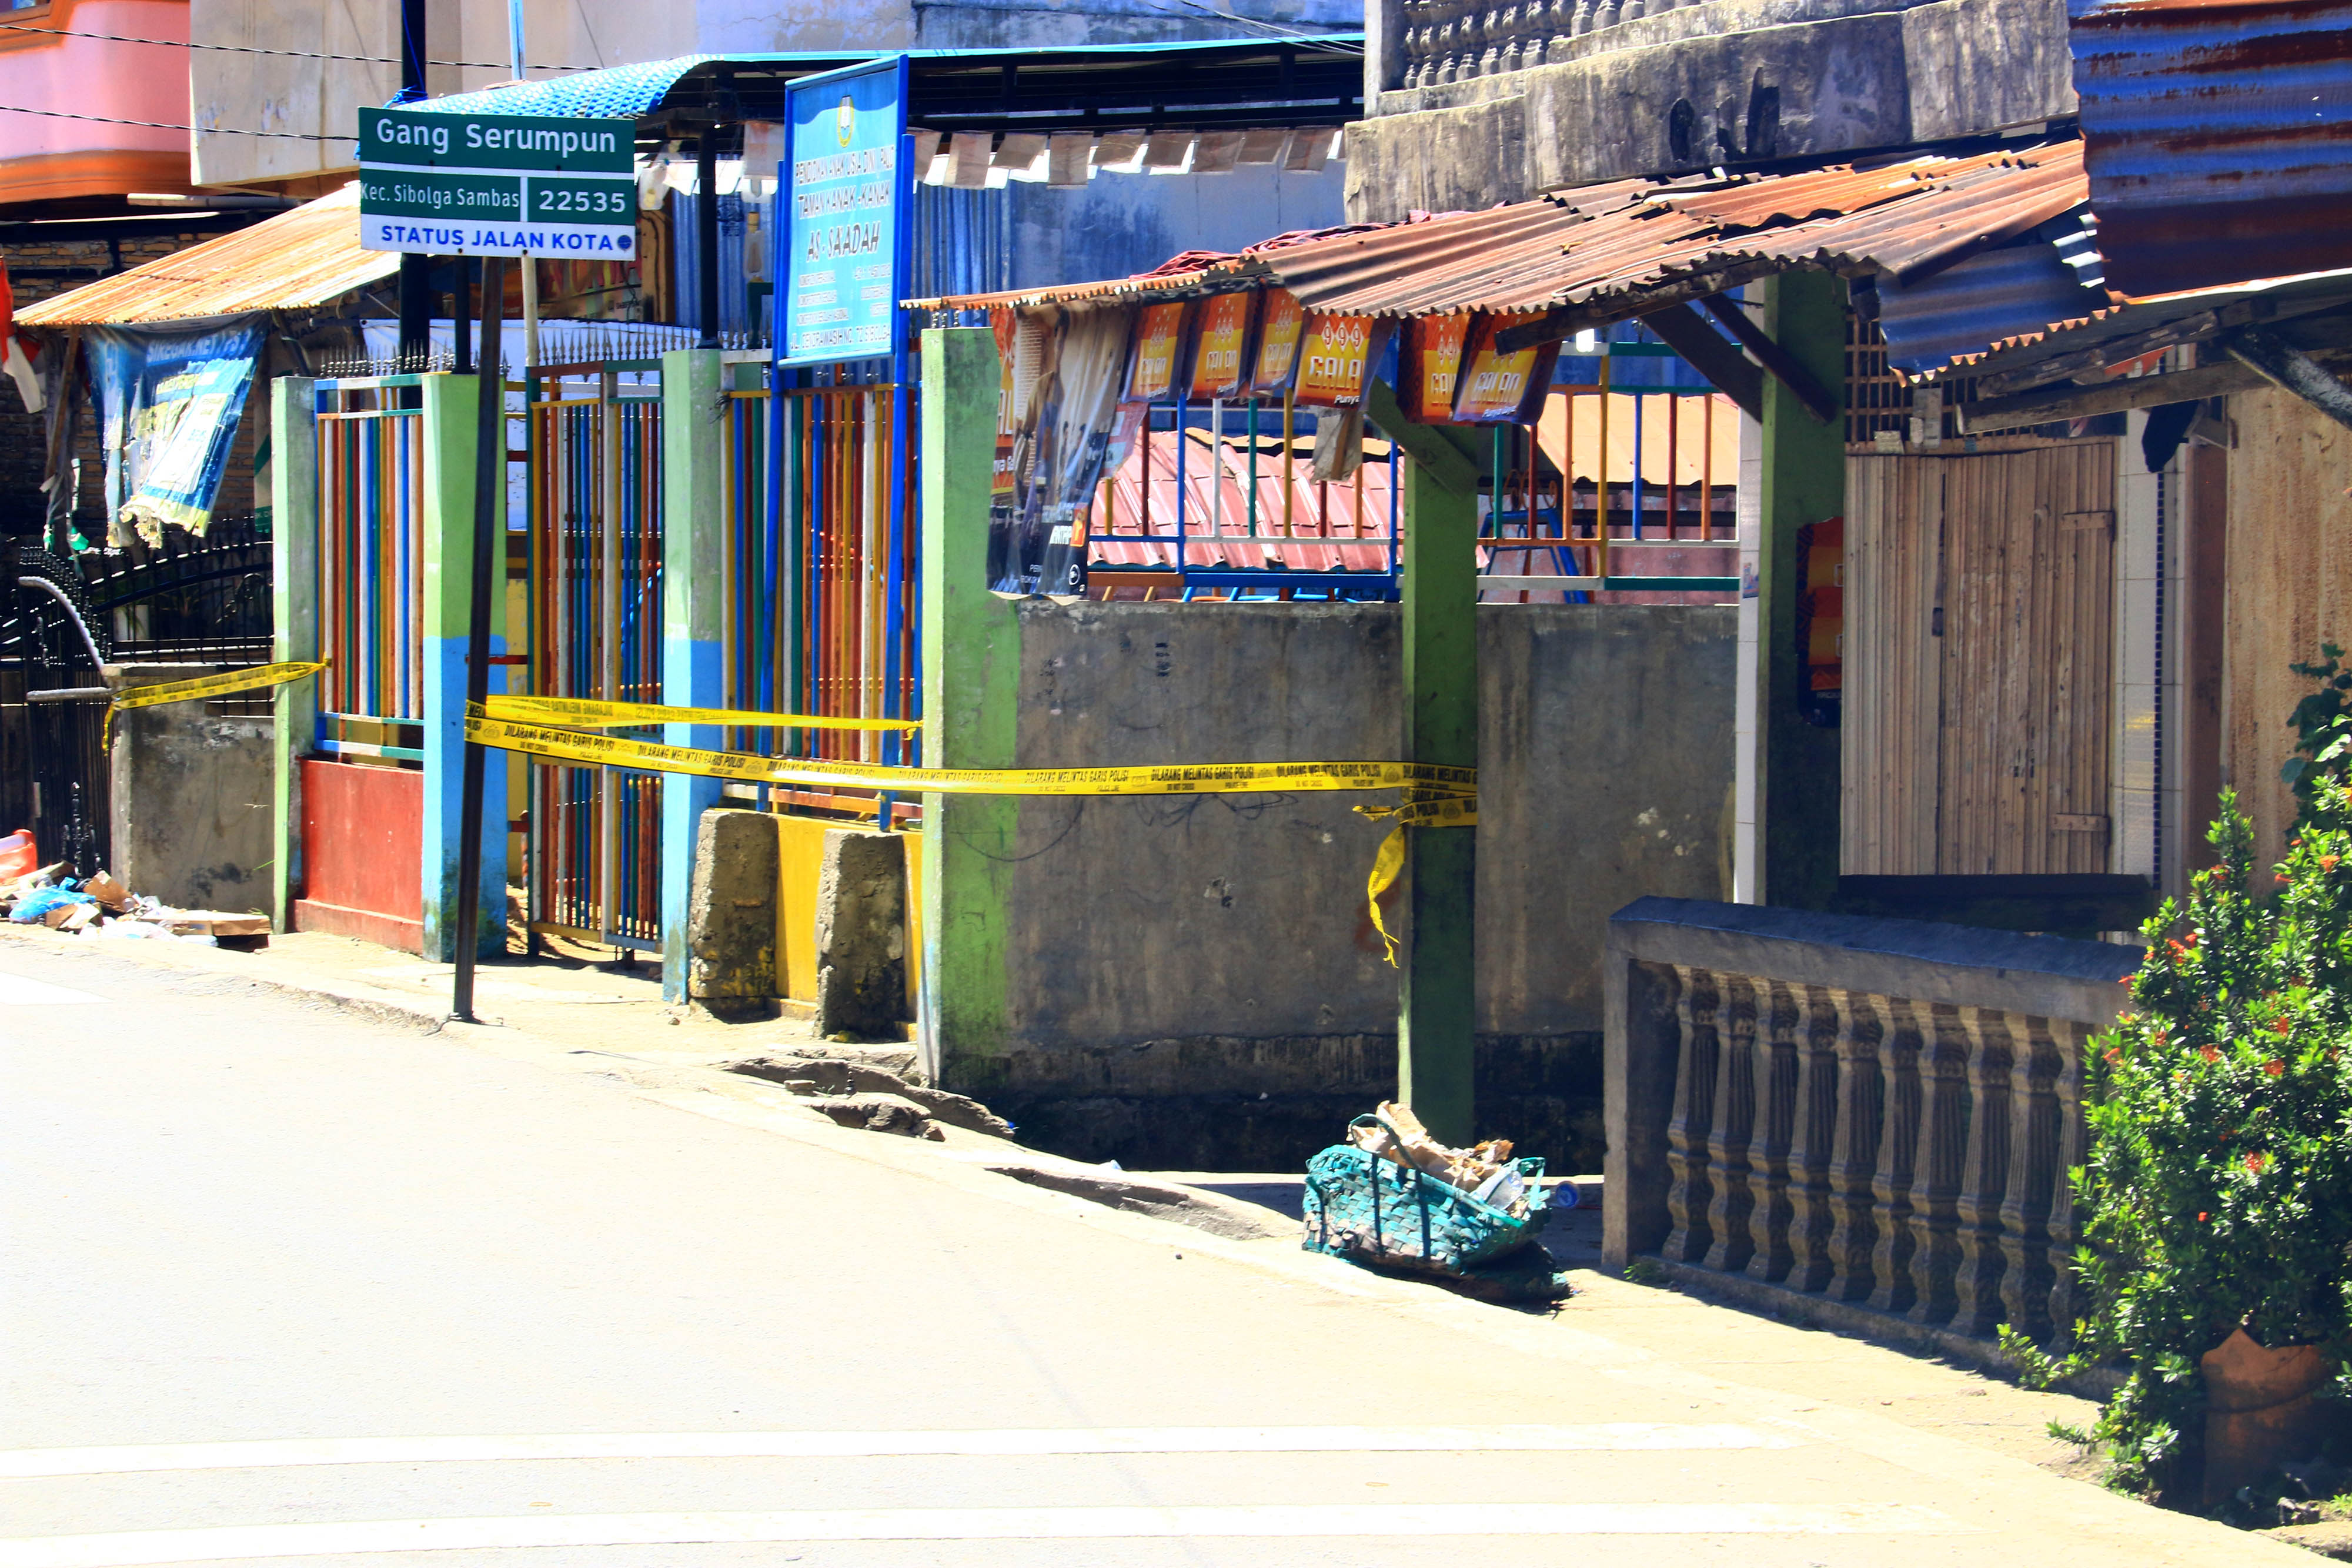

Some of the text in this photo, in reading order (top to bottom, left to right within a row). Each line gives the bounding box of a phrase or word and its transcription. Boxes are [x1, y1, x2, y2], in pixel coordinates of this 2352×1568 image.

[377, 118, 615, 158] Gang Serumpun
[360, 183, 519, 209] Kec. Sibolga Sambas
[539, 190, 625, 213] 22535
[797, 192, 825, 219] TAMAN
[382, 225, 613, 250] STATUS JALAN KOTA
[806, 230, 821, 262] AS
[1324, 325, 1361, 347] 999
[1305, 356, 1365, 391] GALA
[505, 725, 614, 751] DILARANG MELINTAS GARIS POLISI
[637, 745, 746, 768] DILARANG MELINTAS GARIS POLISI
[1025, 770, 1129, 783] DILARANG MELINTAS GARIS POLISI
[1151, 765, 1254, 781] DILARANG MELINTAS GARIS POLISI
